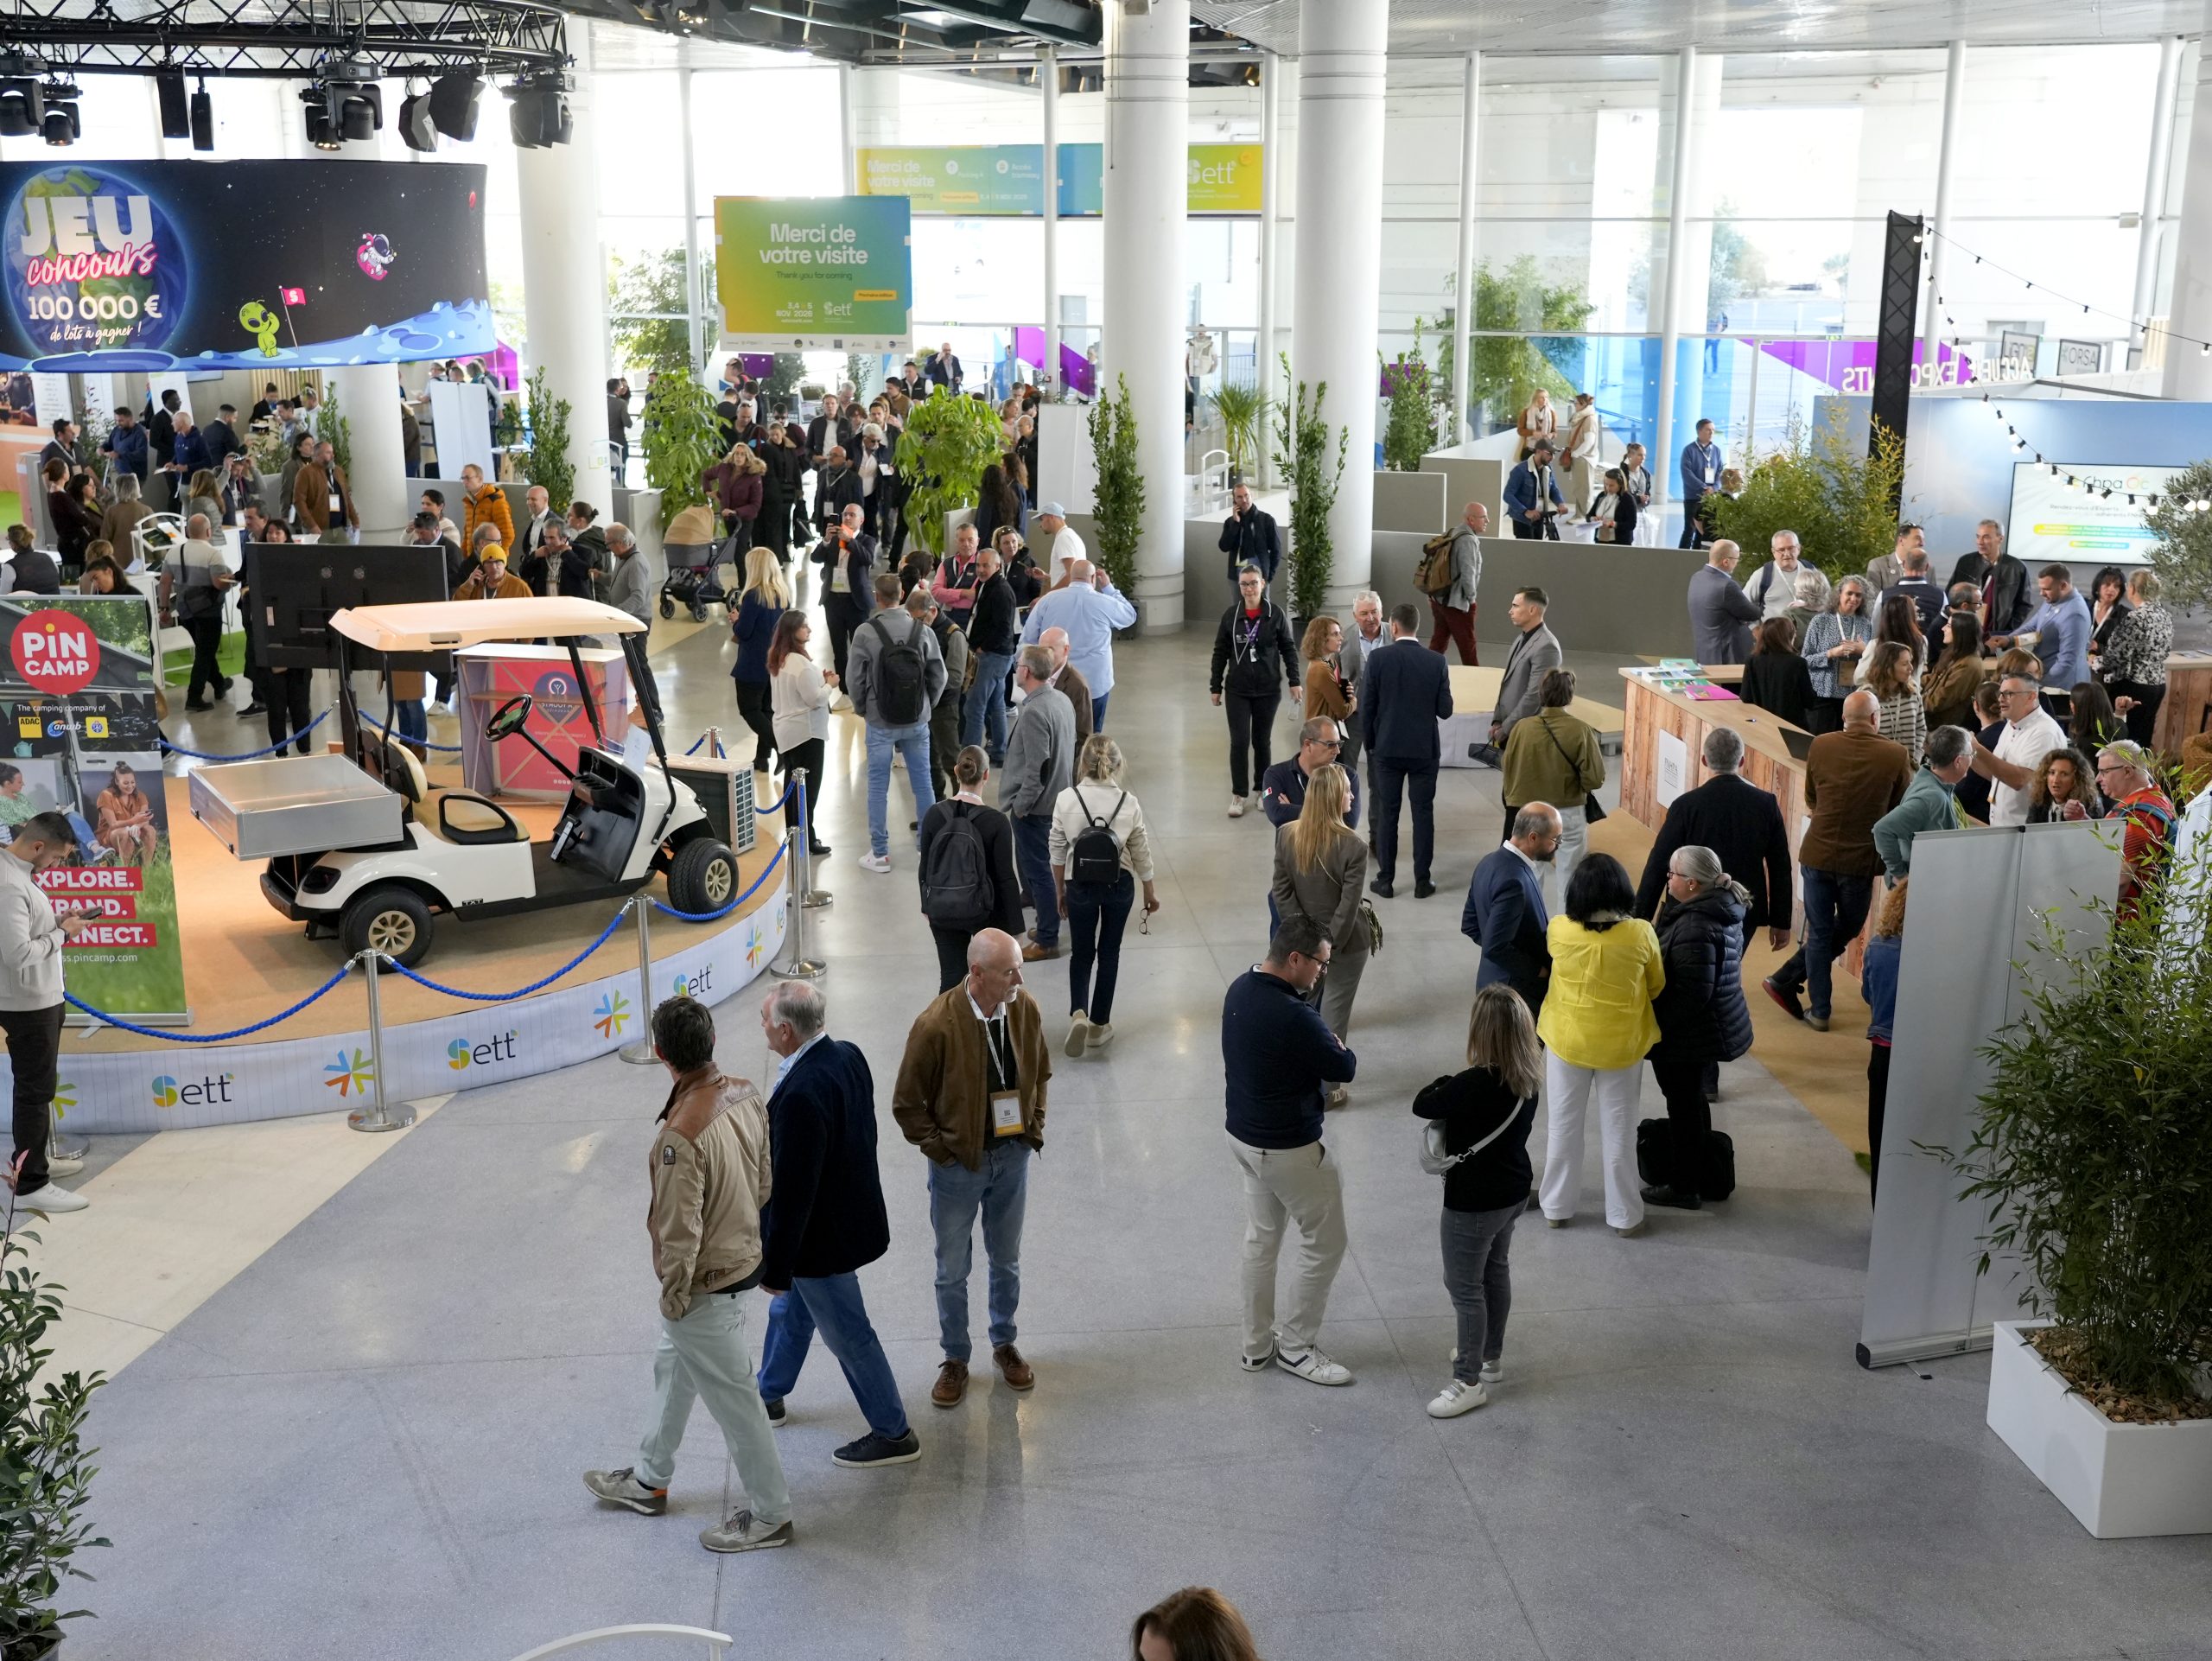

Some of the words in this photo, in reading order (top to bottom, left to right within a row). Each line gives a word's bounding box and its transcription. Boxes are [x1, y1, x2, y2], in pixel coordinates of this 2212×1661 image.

[867, 159, 900, 173] Merci
[903, 160, 920, 173] de
[867, 175, 899, 188] votre
[901, 175, 935, 188] visite
[21, 195, 153, 256] JEU
[770, 223, 826, 243] Merci
[830, 224, 856, 243] de
[760, 246, 812, 264] votre
[815, 245, 868, 264] visite
[27, 242, 158, 286] concours
[776, 270, 798, 279] Thank
[800, 272, 814, 281] you
[815, 270, 824, 279] for
[825, 271, 853, 281] coming
[289, 290, 299, 303] S
[28, 296, 73, 320] 100
[79, 295, 138, 319] 000
[143, 295, 162, 318] €
[823, 301, 852, 316] Sett
[50, 325, 61, 342] de
[64, 324, 83, 340] lots
[86, 327, 94, 338] à
[95, 325, 133, 345] gagner
[25, 660, 90, 675] CAMP
[33, 704, 63, 713] camping
[54, 722, 82, 730] anwb
[35, 870, 135, 888] XPLORE.
[63, 954, 138, 964] ss.pincamp.com
[674, 964, 712, 997] Sett
[448, 1031, 517, 1071] Sett
[152, 1073, 232, 1108] Sett
